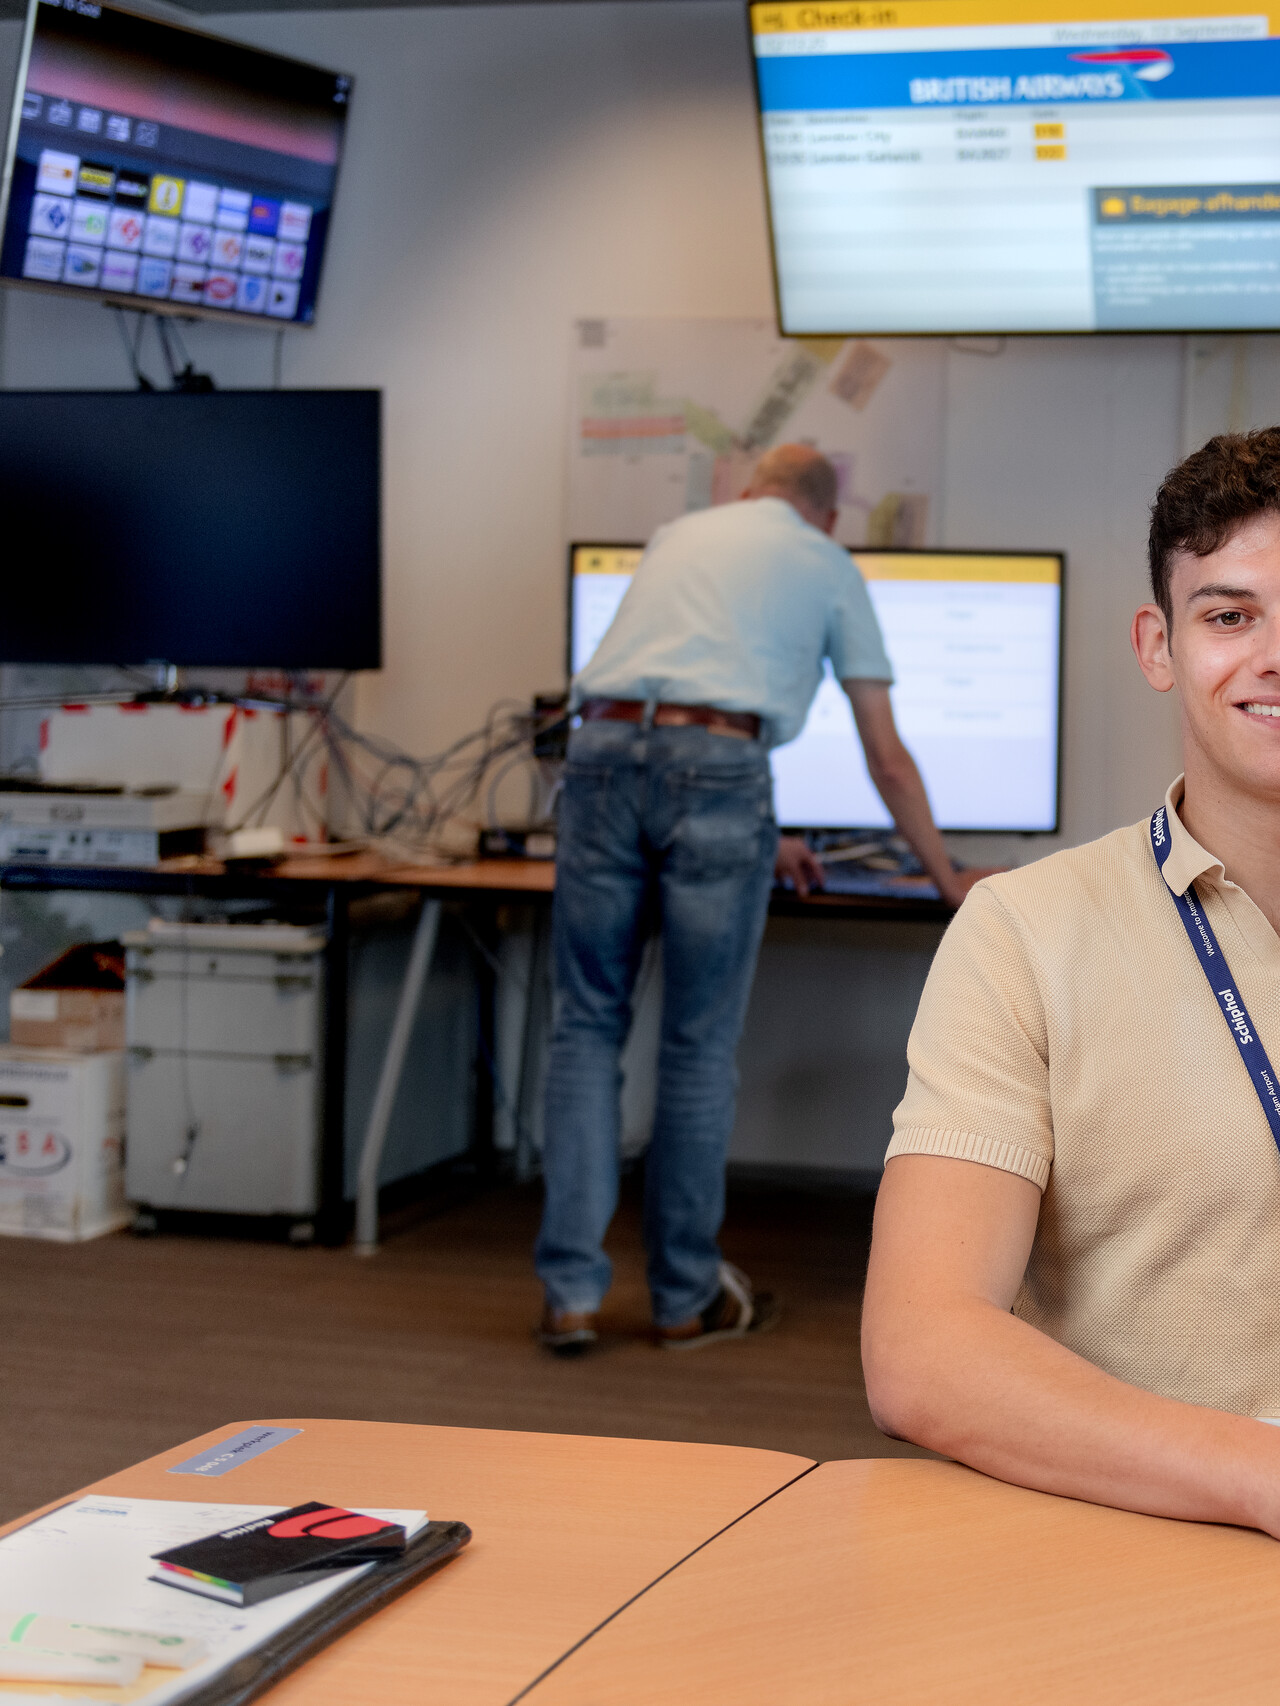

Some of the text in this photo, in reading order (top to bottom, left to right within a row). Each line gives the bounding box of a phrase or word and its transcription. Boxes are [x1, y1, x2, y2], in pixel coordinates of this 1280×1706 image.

[909, 72, 1125, 103] BRITISH AIRWAYS
[1152, 805, 1167, 847] Schiphol
[1194, 916, 1202, 926] to
[1198, 924, 1215, 957] Welcome
[1217, 988, 1254, 1045] Schiphol
[1260, 1069, 1277, 1096] Airport
